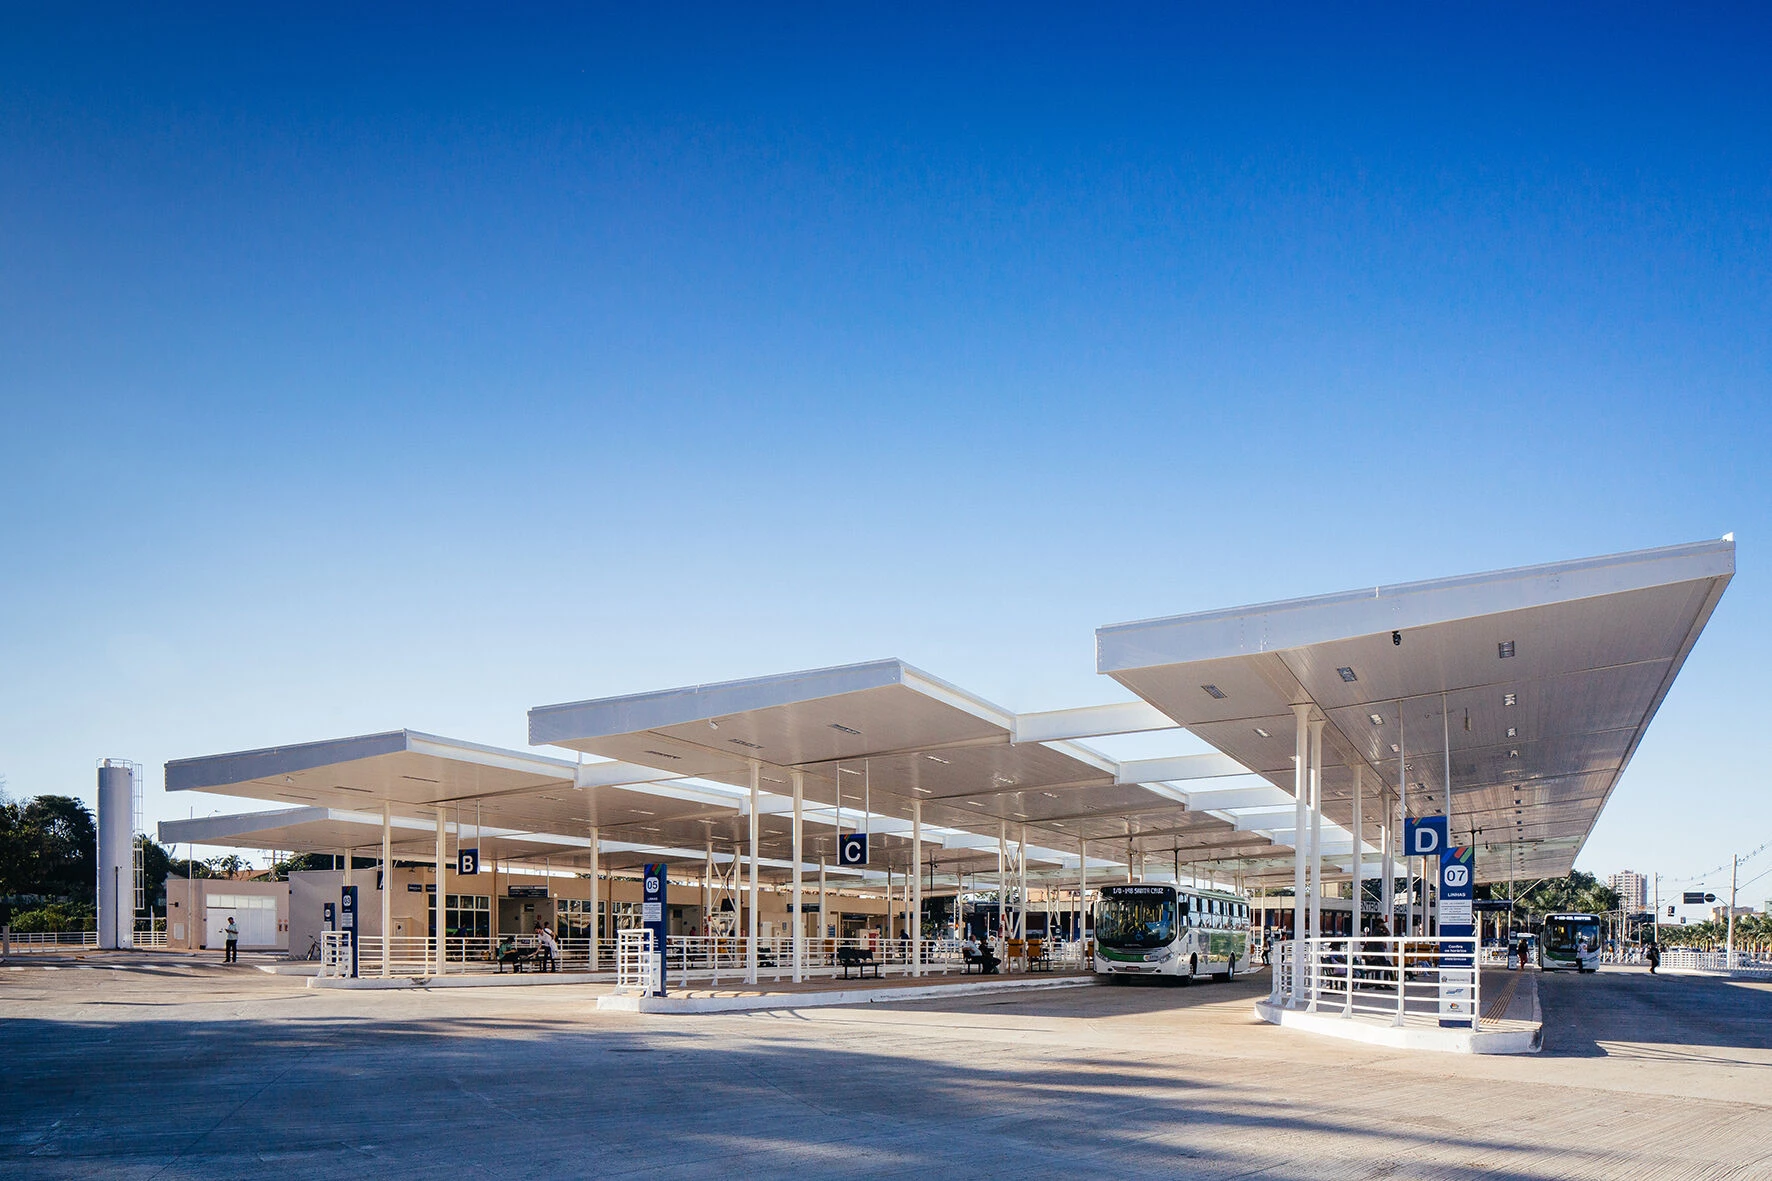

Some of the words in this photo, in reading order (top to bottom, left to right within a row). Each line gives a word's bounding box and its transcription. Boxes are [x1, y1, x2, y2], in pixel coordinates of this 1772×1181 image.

[1415, 828, 1438, 852] D
[845, 841, 861, 862] C
[462, 855, 474, 872] B
[1447, 870, 1466, 881] 07
[647, 880, 658, 890] 05
